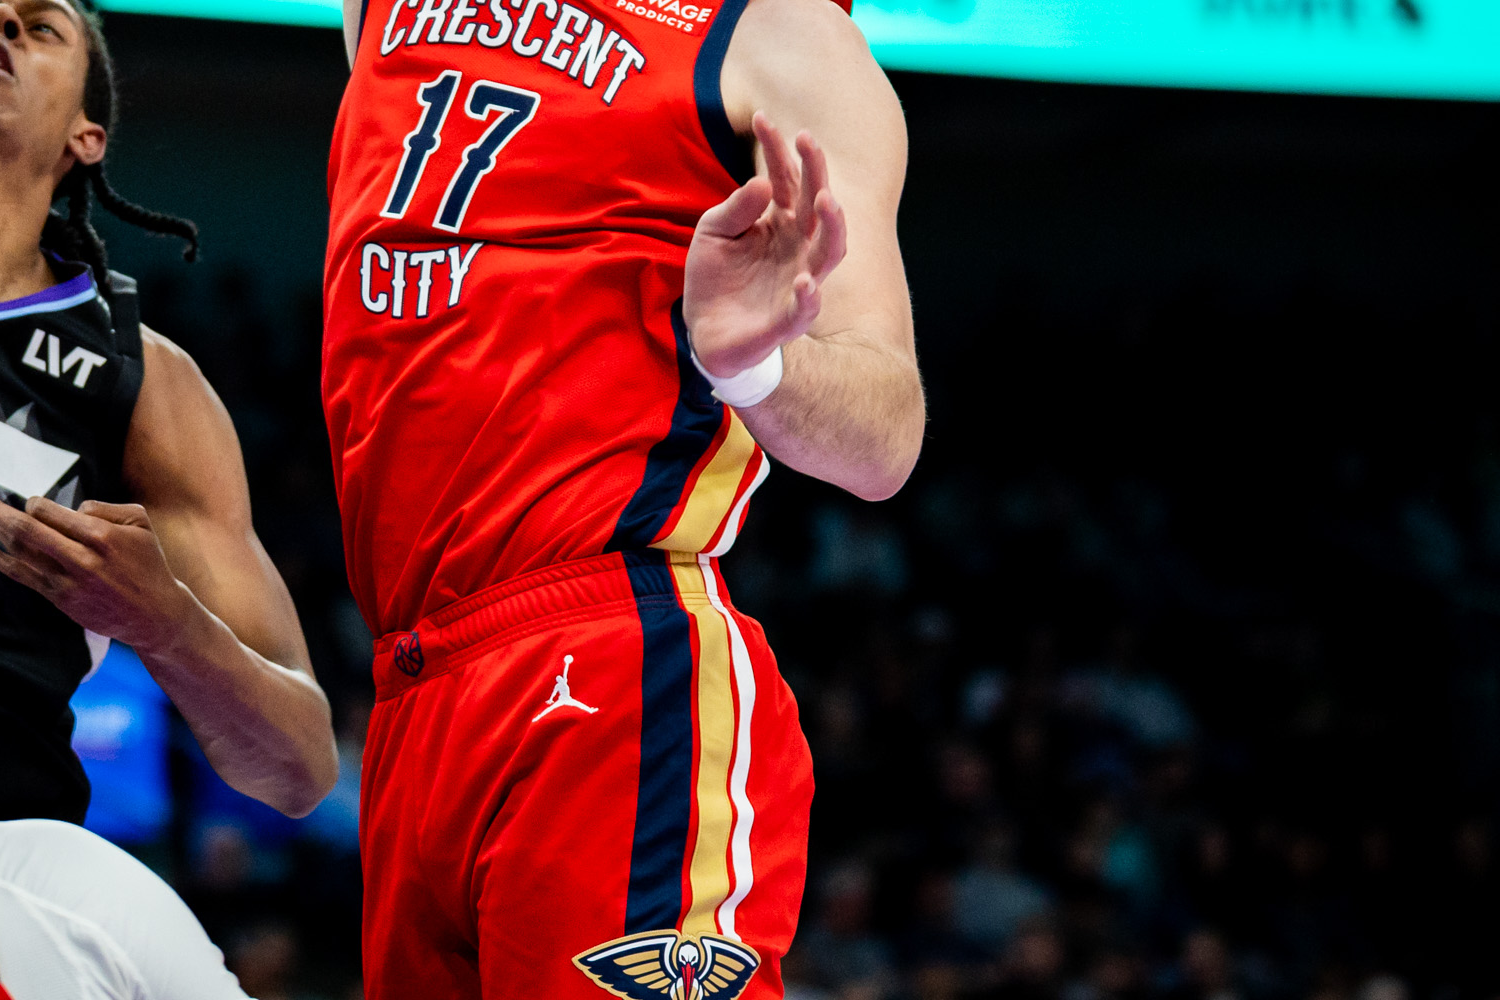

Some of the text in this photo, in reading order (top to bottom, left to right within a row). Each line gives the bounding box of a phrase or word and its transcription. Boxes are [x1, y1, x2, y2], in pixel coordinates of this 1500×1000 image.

[379, 69, 541, 233] 17
[360, 241, 485, 318] CITY
[21, 328, 107, 388] LVT
